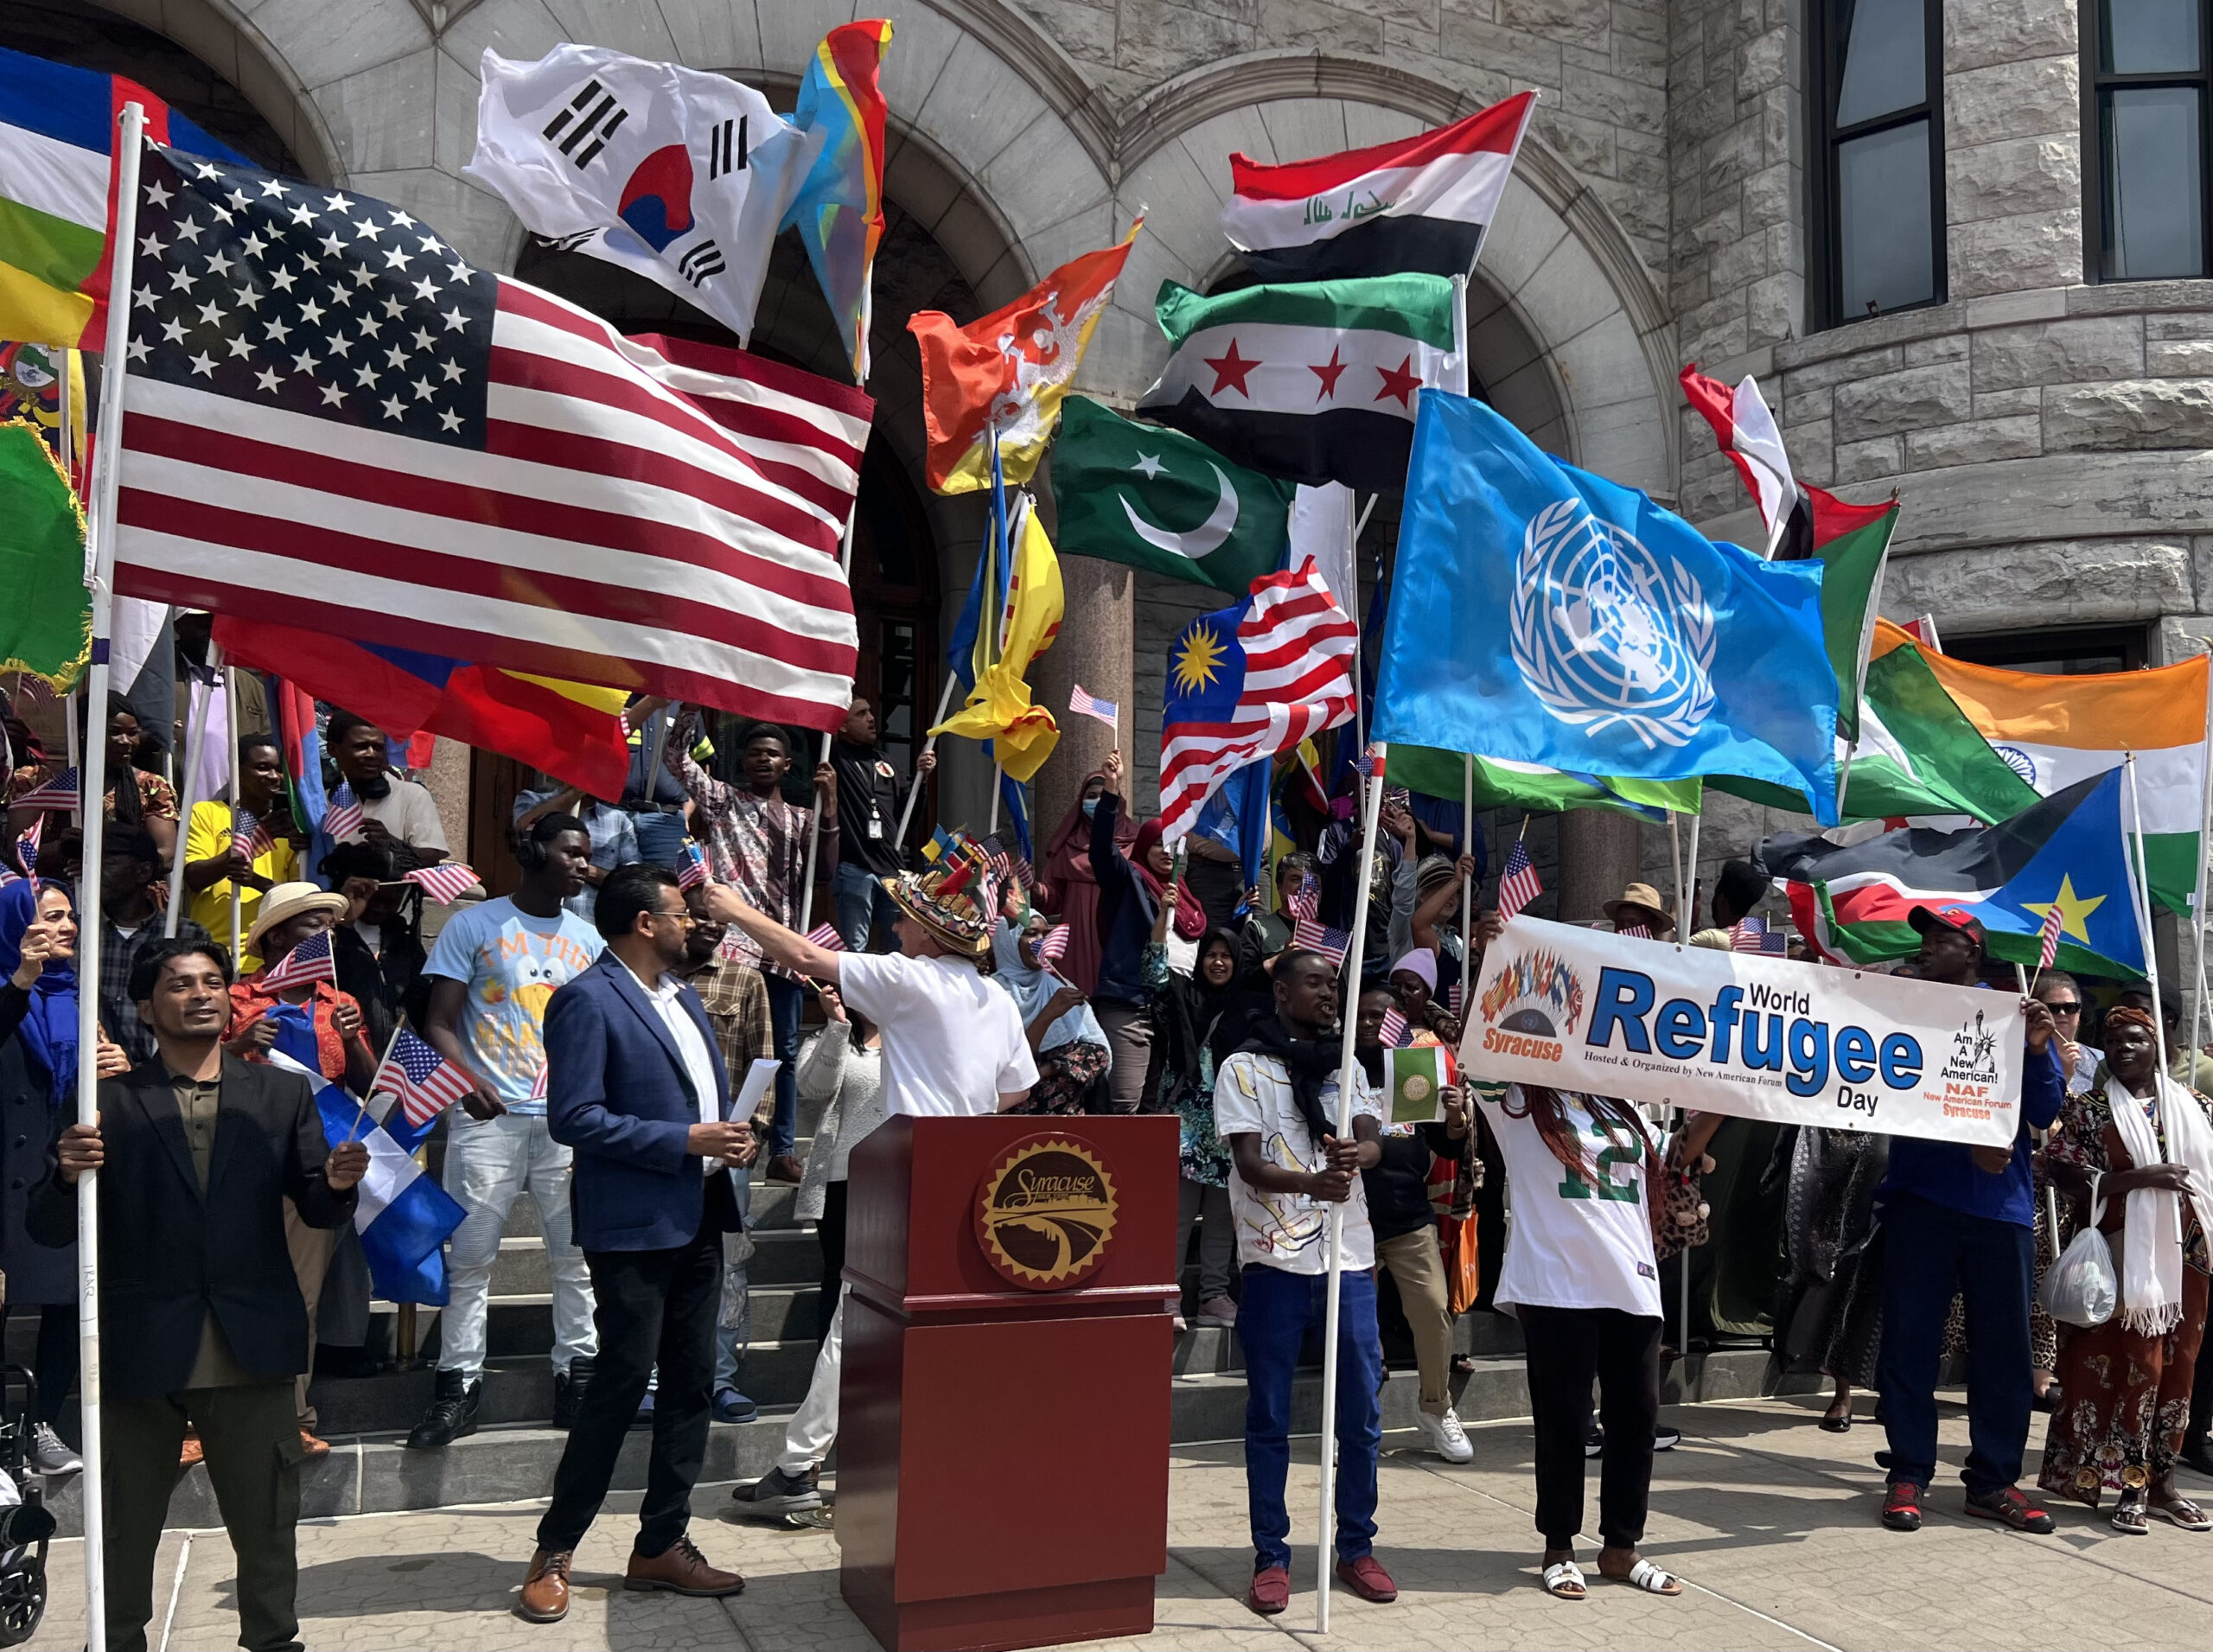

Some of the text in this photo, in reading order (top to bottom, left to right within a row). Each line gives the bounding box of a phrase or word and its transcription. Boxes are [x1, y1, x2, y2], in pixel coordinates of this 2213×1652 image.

[1750, 982, 1810, 1016] World
[1585, 966, 1923, 1098] Refugee
[1963, 1021, 1967, 1032] I
[1483, 1027, 1564, 1062] Syracuse
[1954, 1032, 1973, 1045] Am
[1959, 1045, 1967, 1056] A
[1585, 1050, 1783, 1088] Hosted & Organized by New American Forum
[1950, 1056, 1974, 1069] New
[1941, 1067, 1998, 1084] American!
[1946, 1082, 1989, 1098] NAF
[1837, 1085, 1878, 1117] Day
[1923, 1092, 2012, 1109] New American Forum
[1943, 1103, 1991, 1120] Syracuse
[1559, 1118, 1643, 1204] 12
[1017, 1169, 1094, 1205] Syracuse
